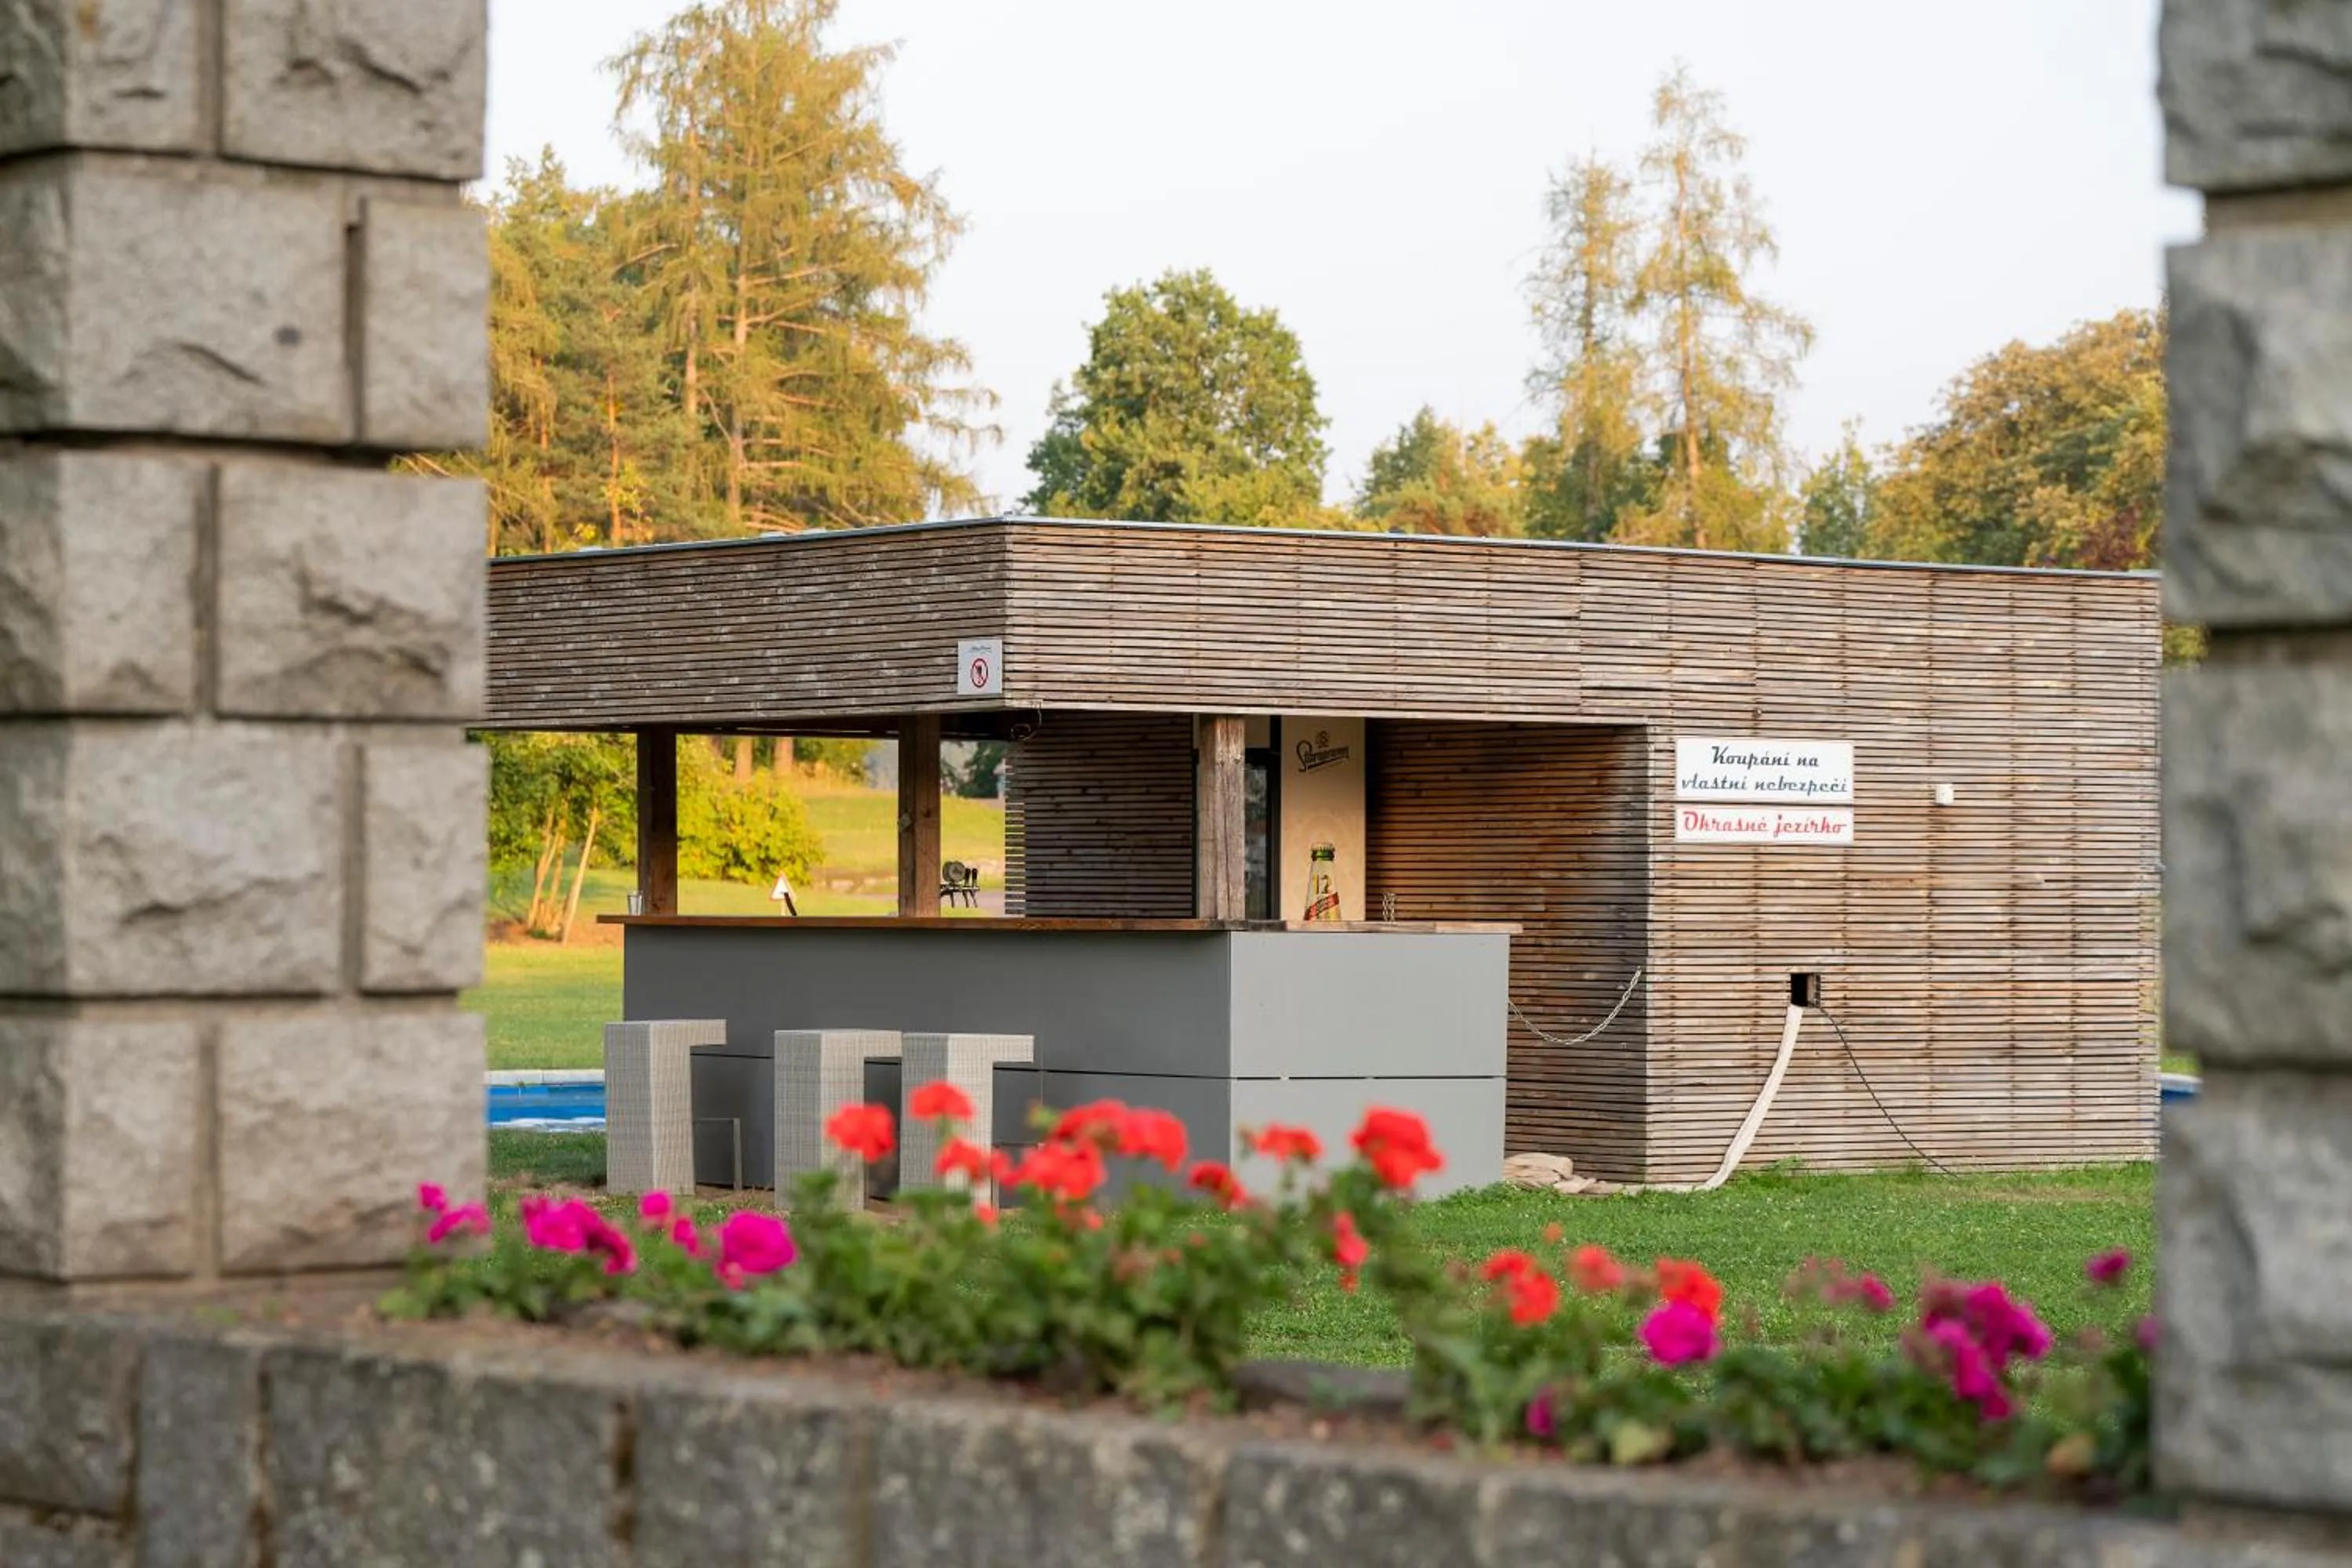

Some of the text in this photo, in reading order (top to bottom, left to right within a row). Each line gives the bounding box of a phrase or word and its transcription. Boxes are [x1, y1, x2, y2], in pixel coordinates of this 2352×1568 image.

[1711, 746, 1820, 770] Koupání na
[1682, 773, 1848, 797] vlastní nebezpečí
